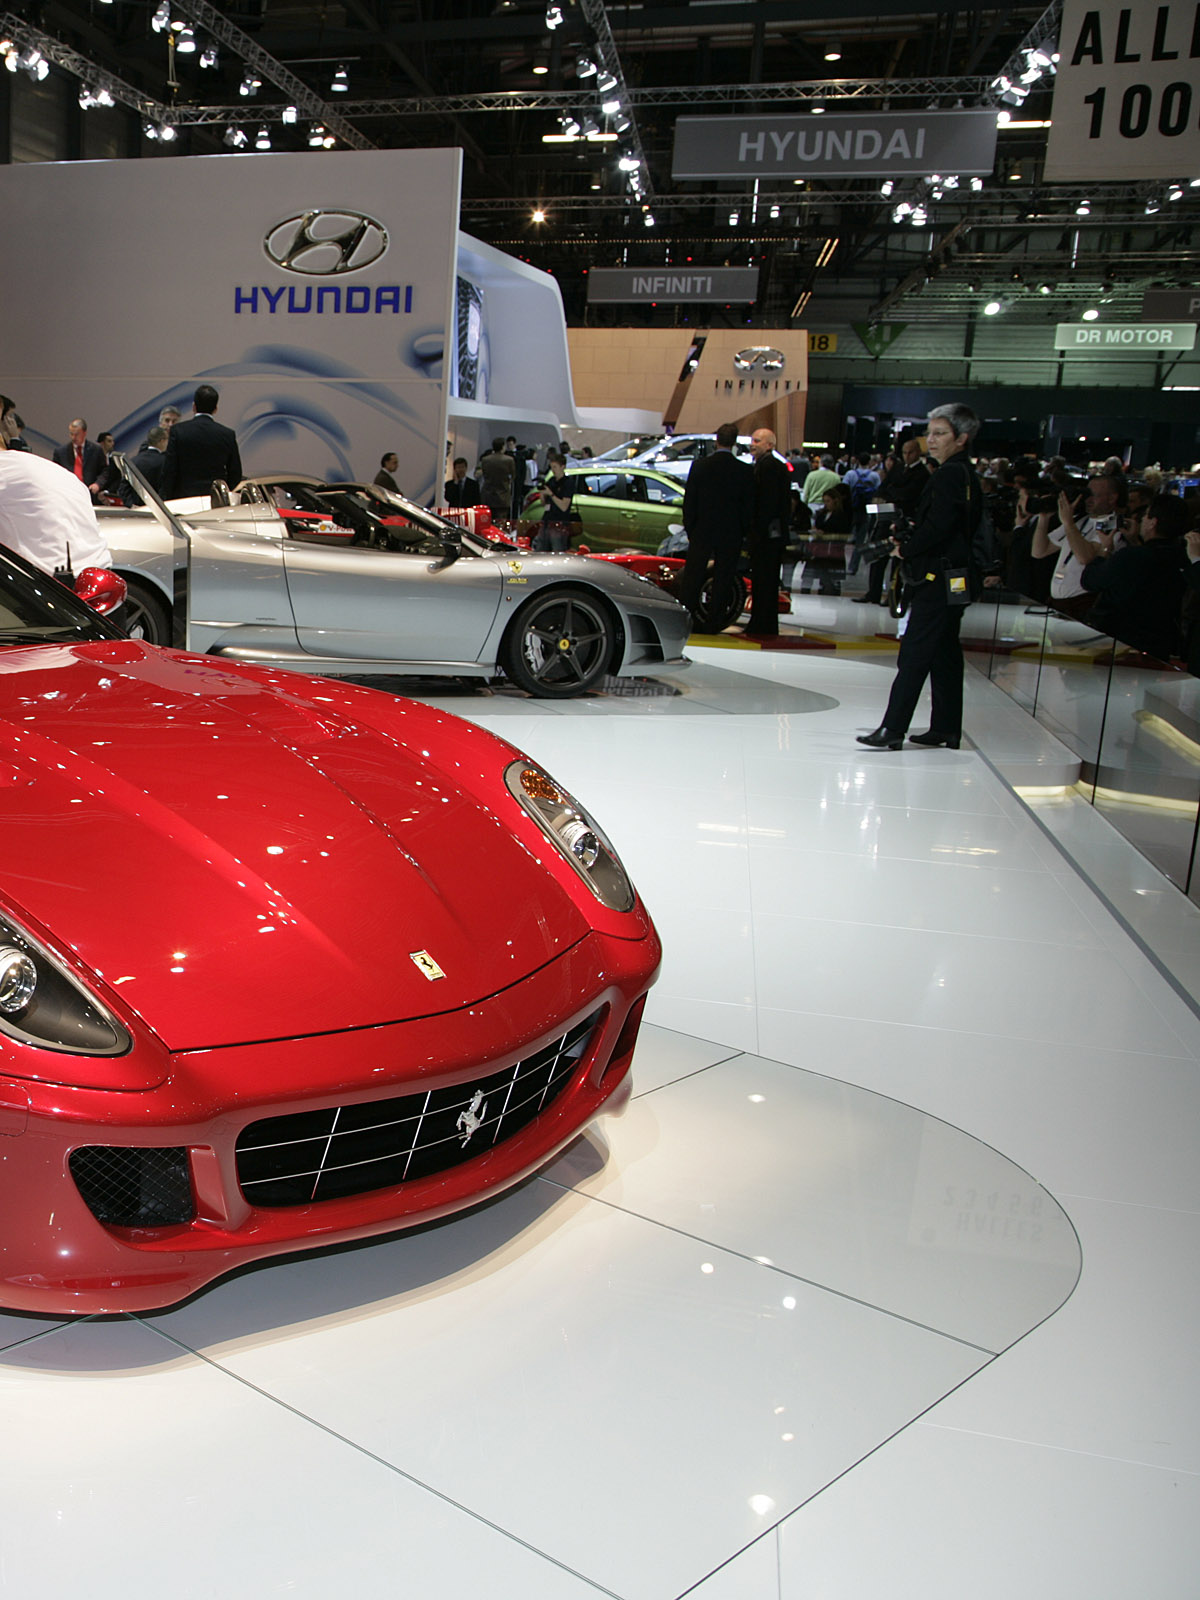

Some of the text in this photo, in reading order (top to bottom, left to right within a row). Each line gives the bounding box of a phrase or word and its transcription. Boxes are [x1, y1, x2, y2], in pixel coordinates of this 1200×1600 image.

[1083, 81, 1200, 140] 100
[738, 128, 926, 162] HYUNDAI
[632, 276, 713, 295] INFINITI
[234, 285, 414, 314] HYUNDAI
[810, 335, 829, 351] 18
[1075, 329, 1174, 344] DR MOTOR
[715, 378, 802, 391] INFINITI
